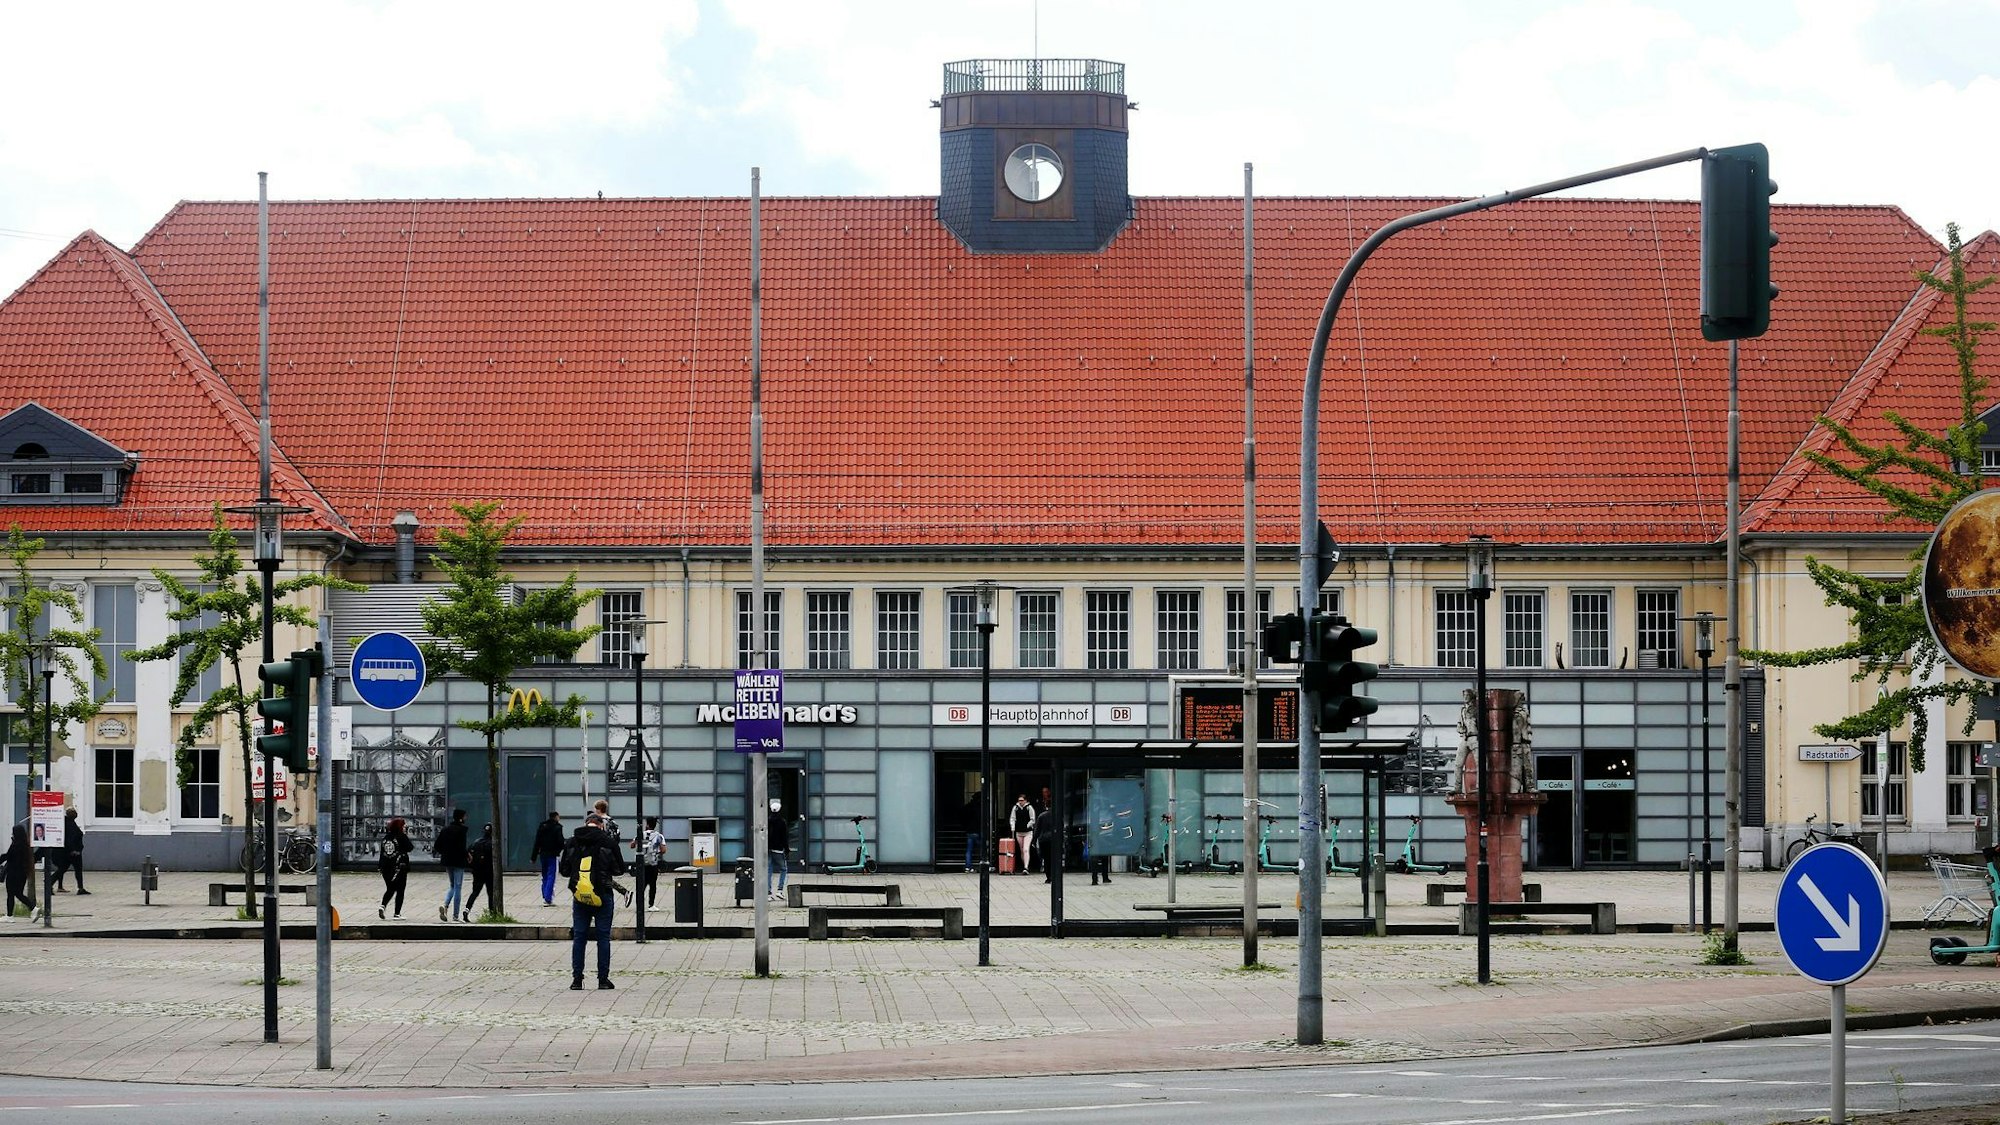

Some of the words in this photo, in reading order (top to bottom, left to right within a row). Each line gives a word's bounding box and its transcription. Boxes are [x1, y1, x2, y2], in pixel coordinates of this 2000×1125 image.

[1946, 588, 1994, 598] Willkommen
[736, 673, 780, 688] WÄHLEN
[736, 688, 779, 702] RETTET
[697, 704, 857, 723] Mcnald's
[736, 703, 780, 720] LEBEN
[950, 709, 967, 720] DB
[990, 709, 1089, 723] Hauptbahnhof
[1112, 709, 1130, 720] DB
[760, 738, 780, 747] Volt
[1806, 751, 1849, 759] Radstation
[273, 788, 285, 797] PD
